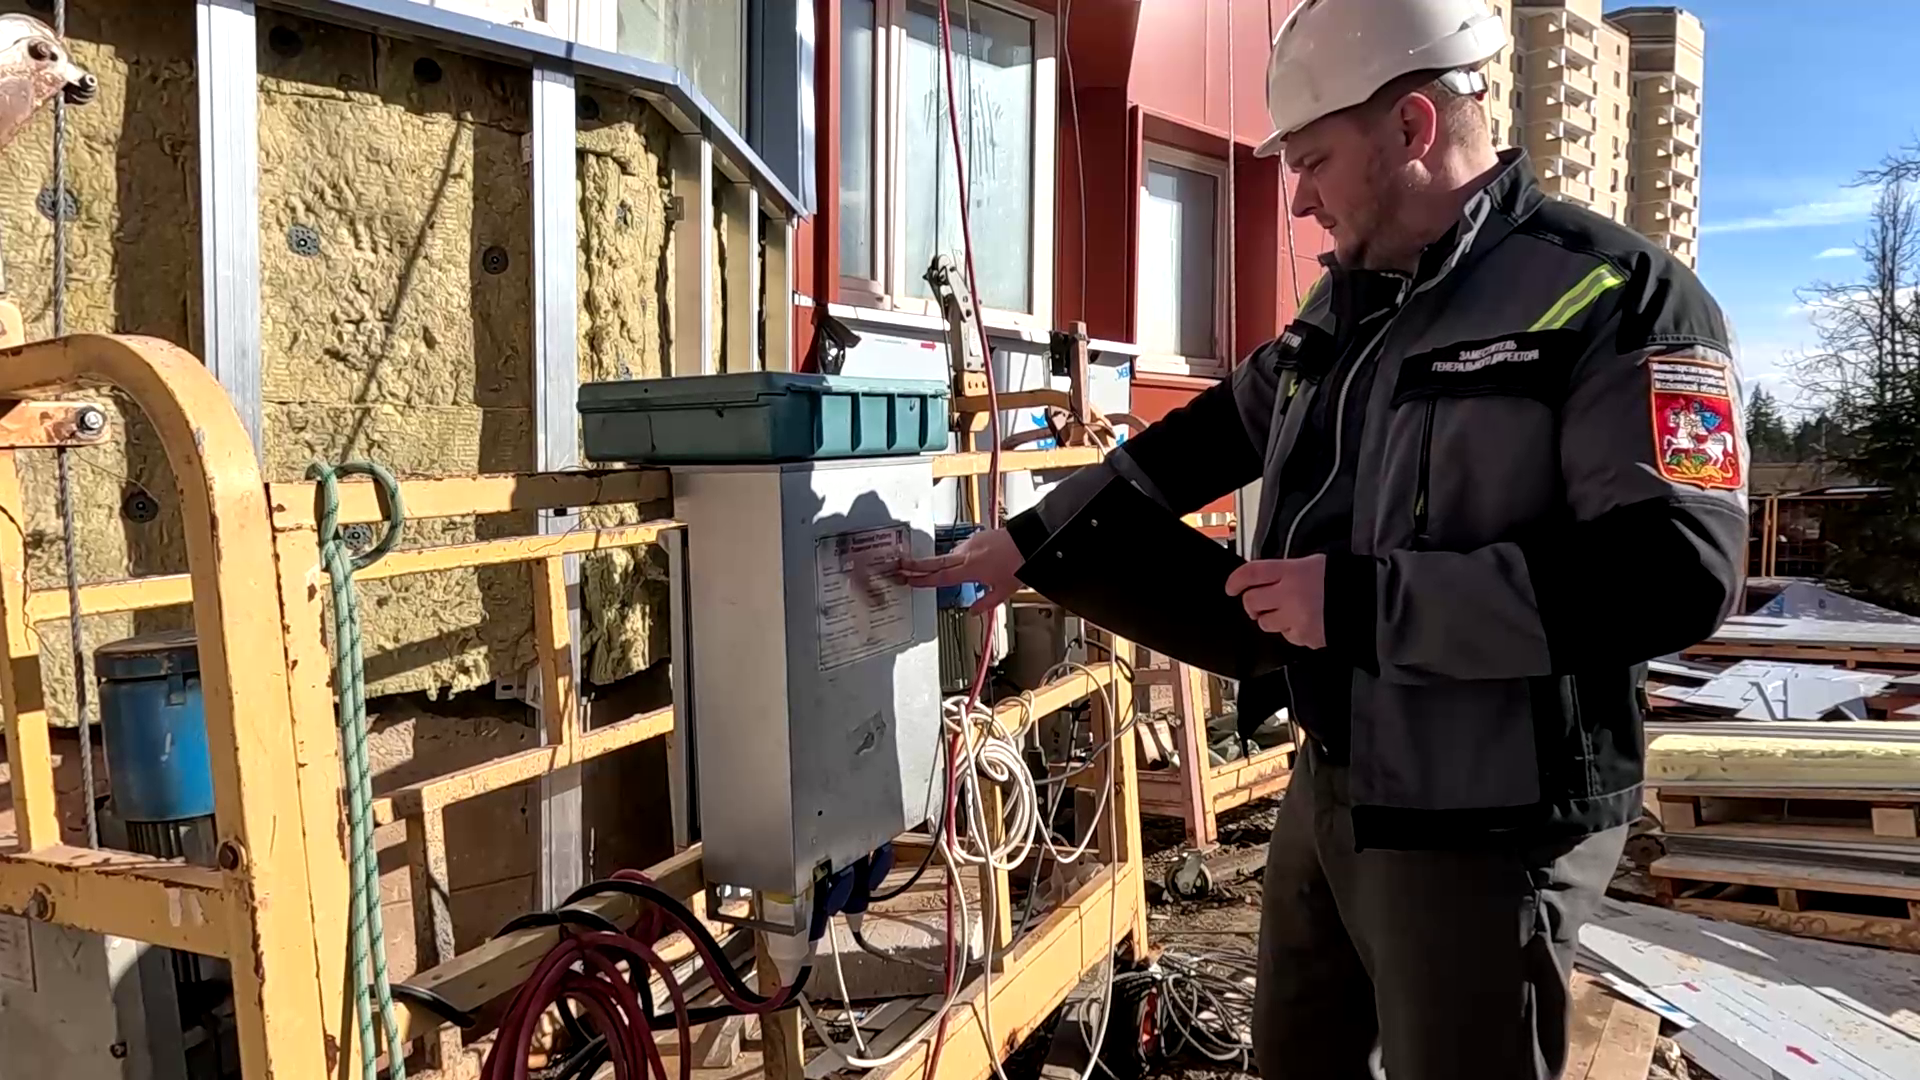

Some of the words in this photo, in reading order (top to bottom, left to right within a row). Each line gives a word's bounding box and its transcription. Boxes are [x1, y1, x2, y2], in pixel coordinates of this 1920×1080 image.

[1432, 358, 1490, 372] ГЕНЕРАЛЬНОГО
[1491, 349, 1539, 364] ДИРЕКТОРА
[1459, 341, 1517, 361] ЗАМЕСТИТЕЛЬ
